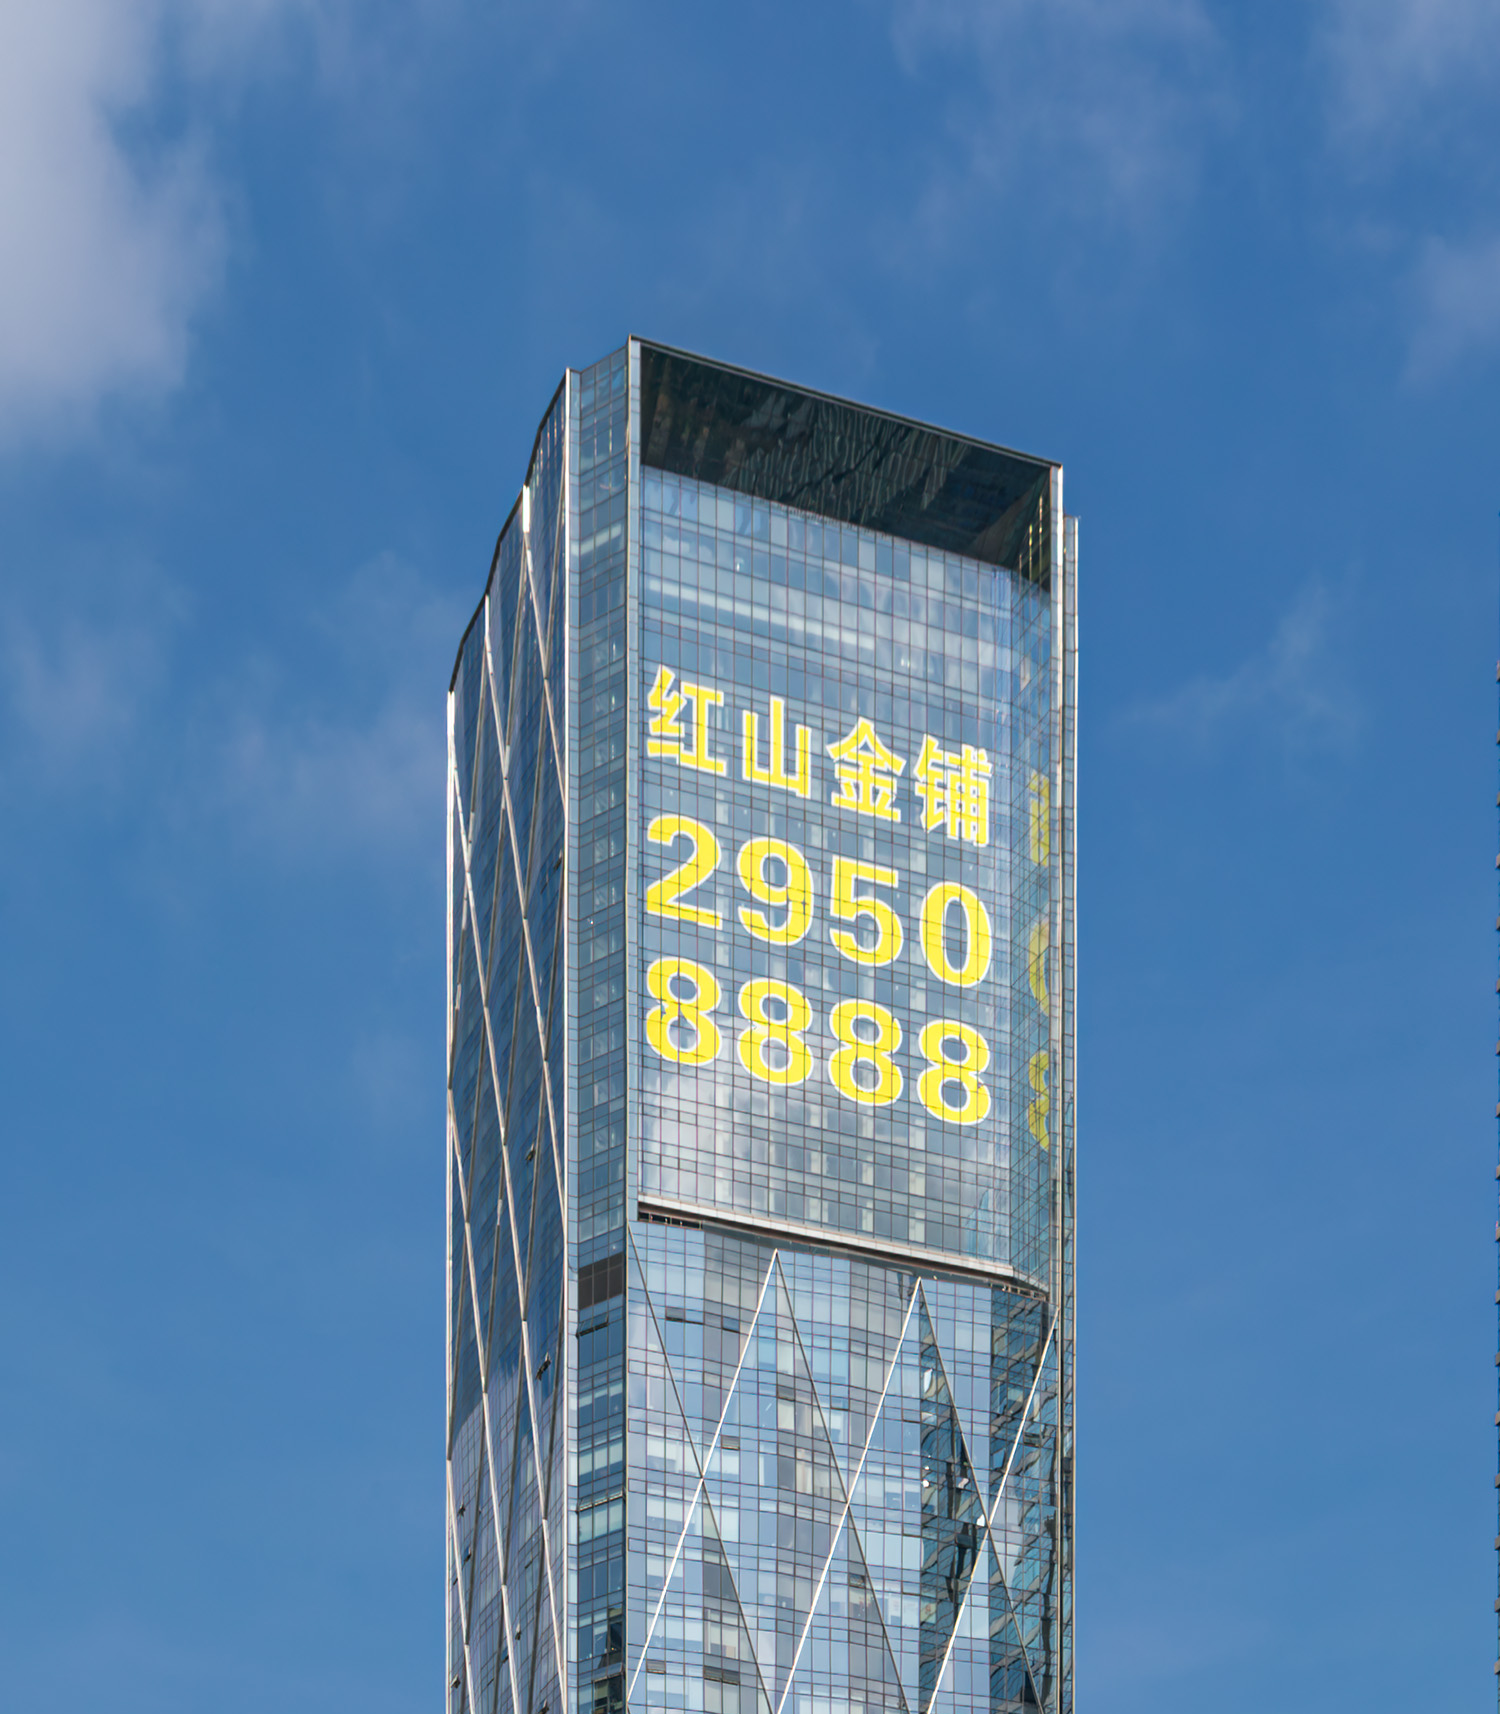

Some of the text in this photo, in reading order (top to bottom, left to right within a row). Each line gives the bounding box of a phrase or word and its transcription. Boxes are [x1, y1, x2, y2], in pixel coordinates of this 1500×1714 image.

[646, 664, 993, 847] 红山金铺
[646, 814, 992, 989] 2950
[645, 956, 991, 1126] 8888
